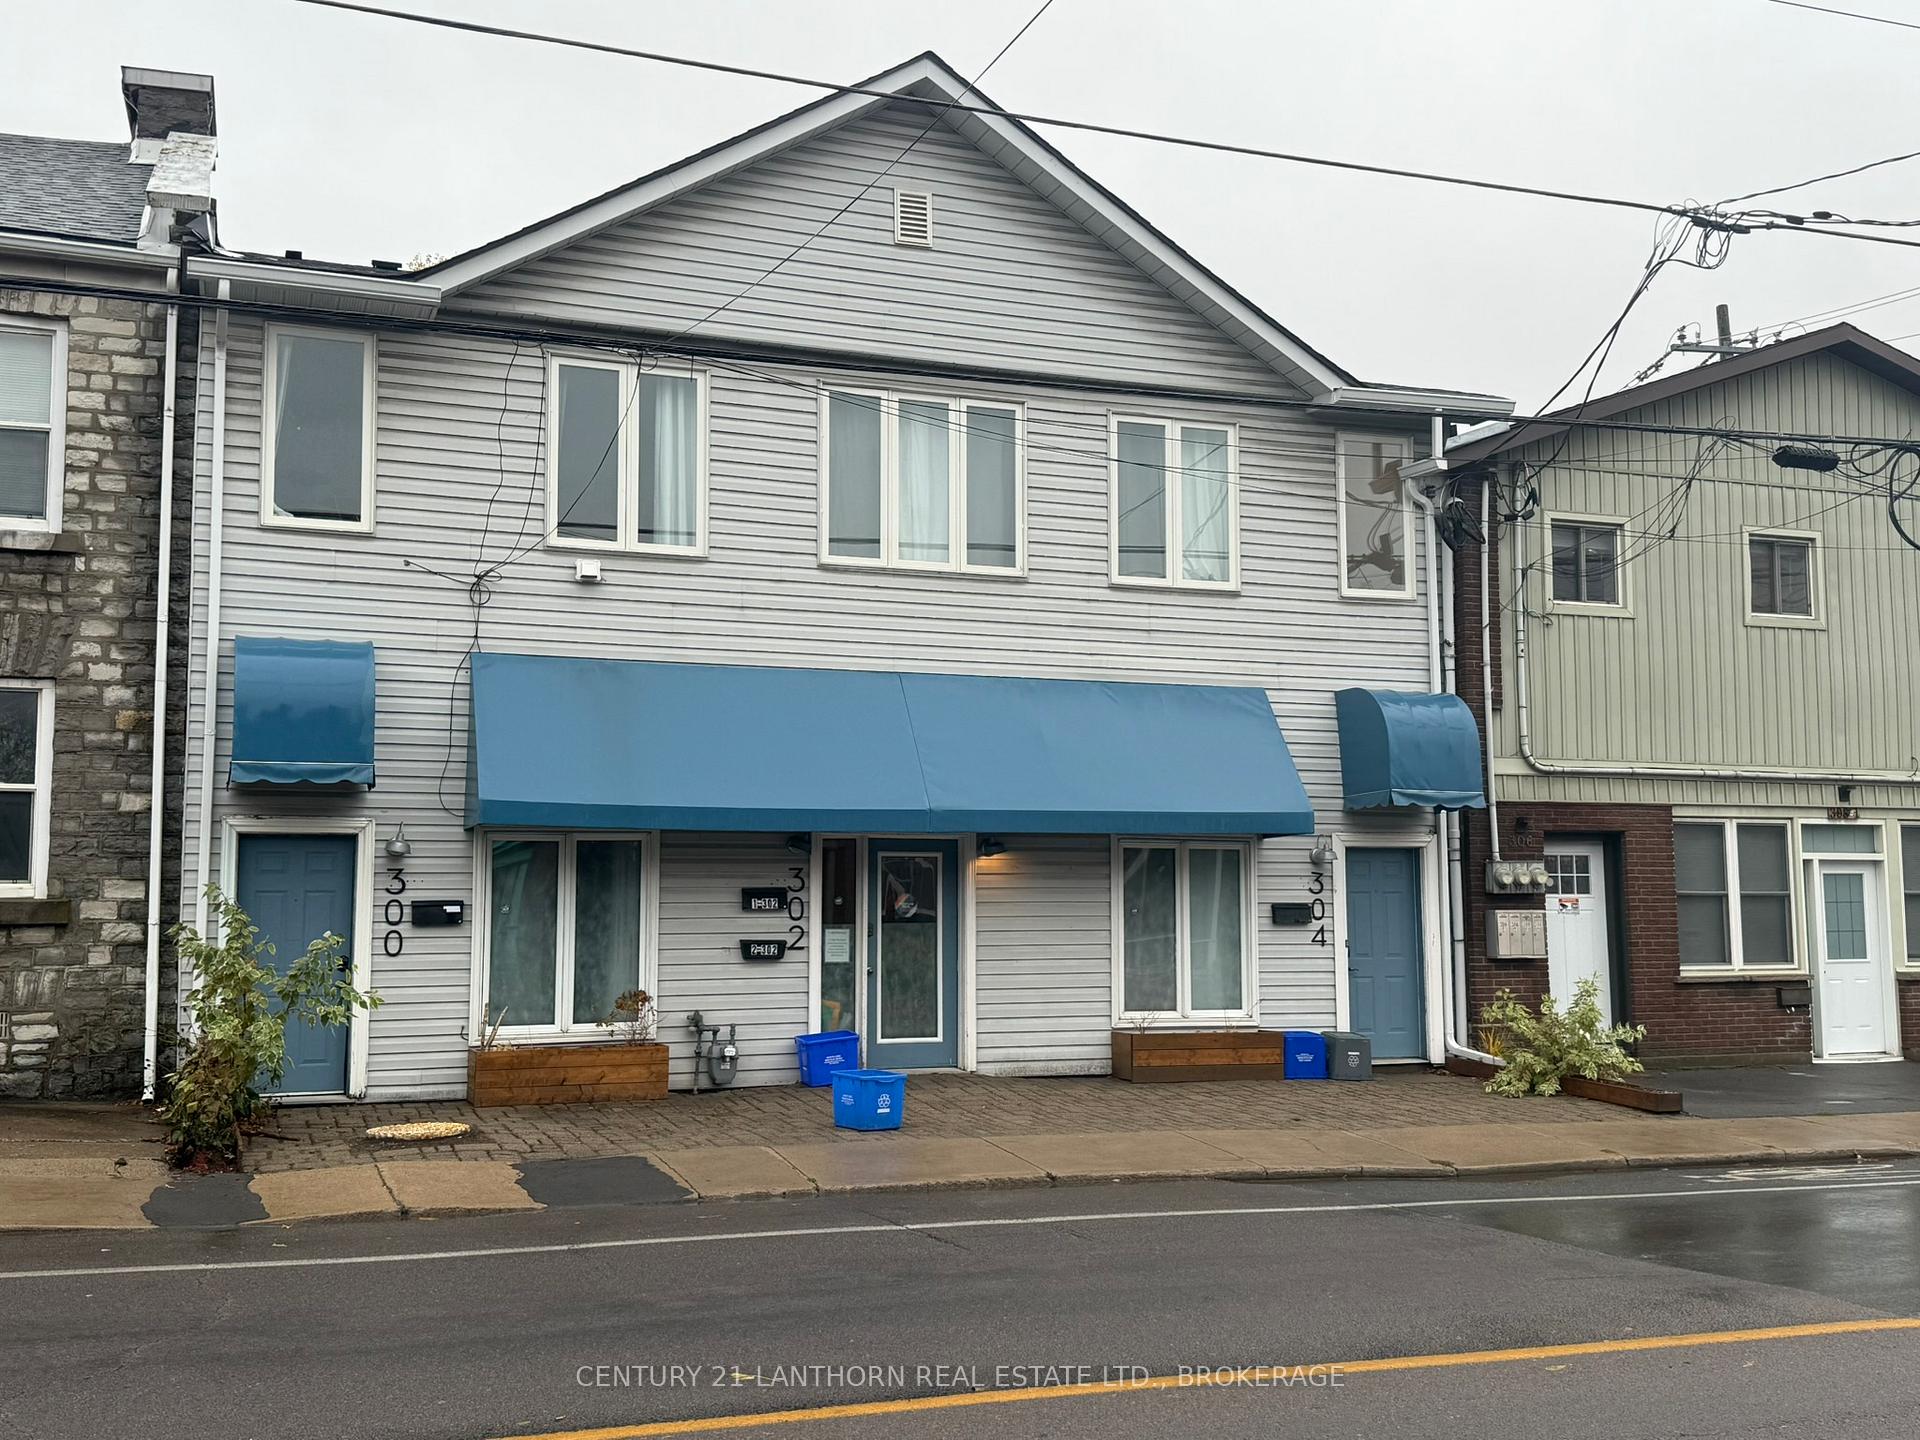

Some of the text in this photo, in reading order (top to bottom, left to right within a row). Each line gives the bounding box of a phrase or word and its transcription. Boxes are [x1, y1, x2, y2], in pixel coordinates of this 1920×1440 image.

[384, 868, 406, 957] 300
[787, 867, 805, 950] 302
[1309, 872, 1327, 947] 304
